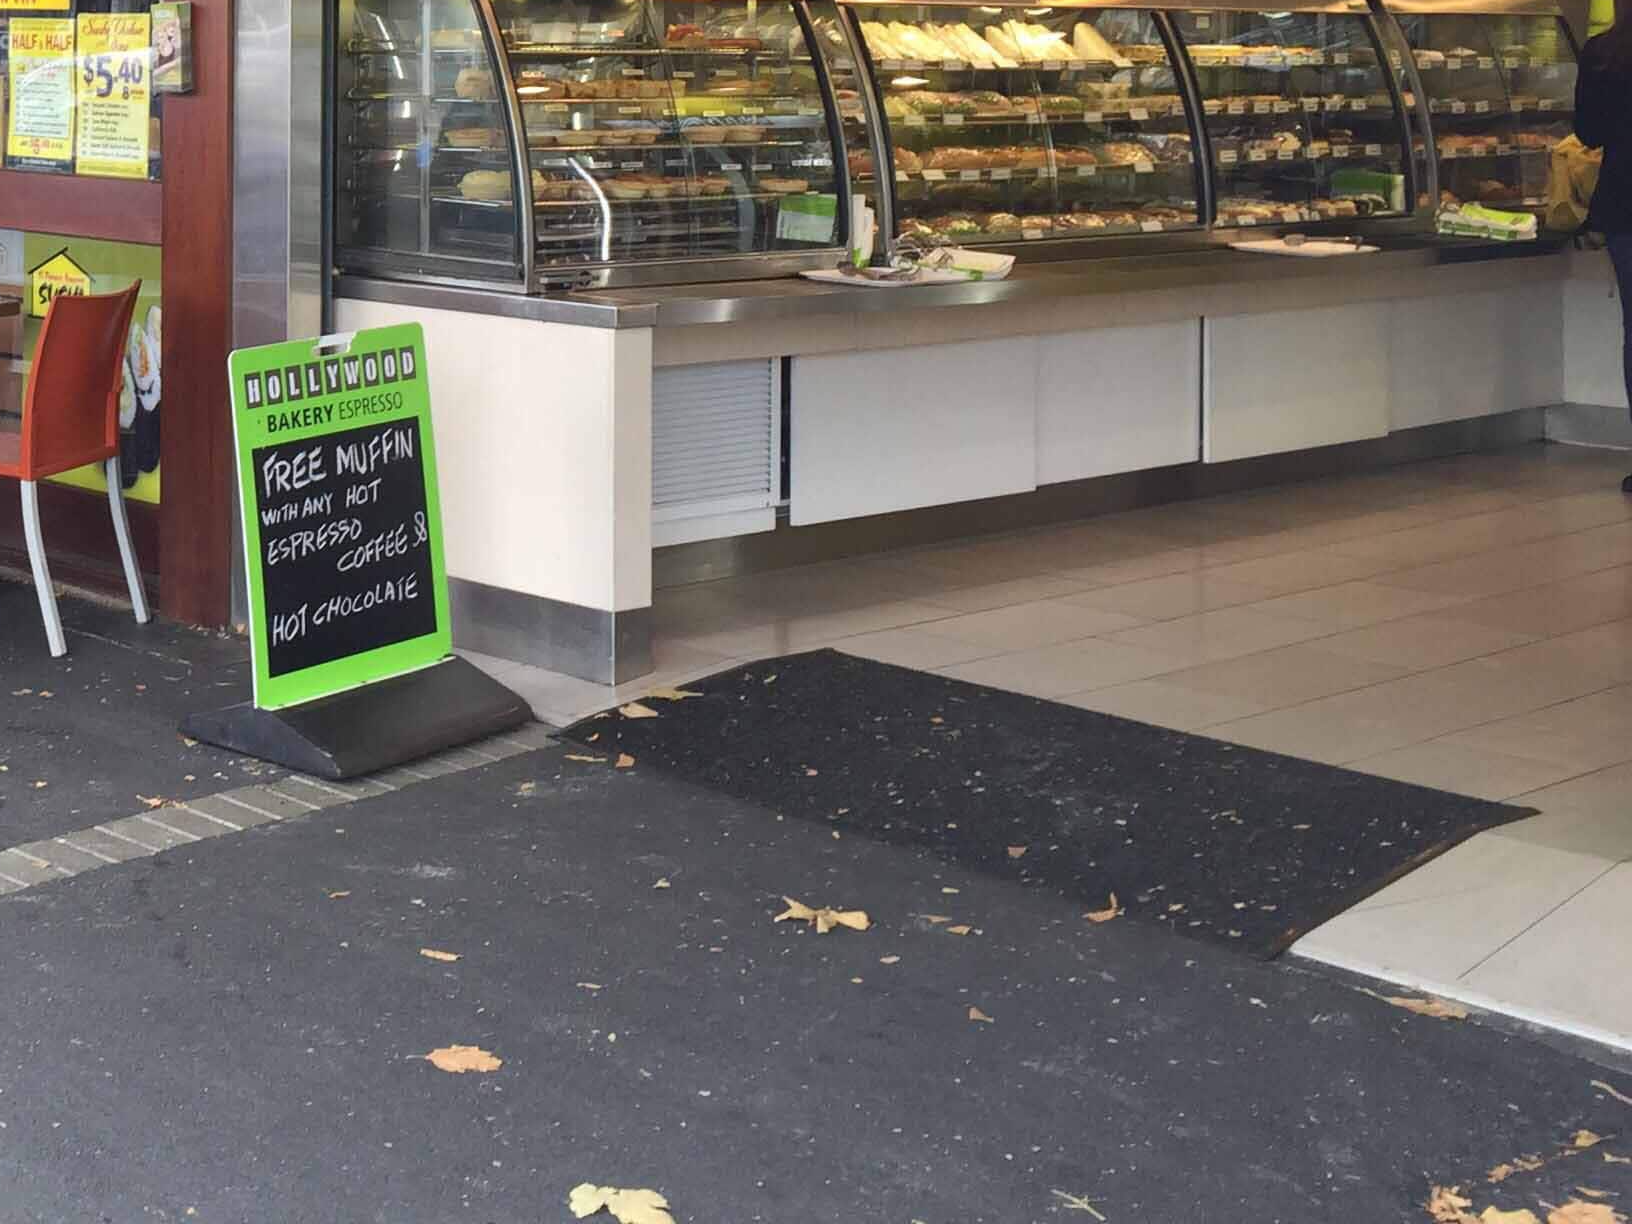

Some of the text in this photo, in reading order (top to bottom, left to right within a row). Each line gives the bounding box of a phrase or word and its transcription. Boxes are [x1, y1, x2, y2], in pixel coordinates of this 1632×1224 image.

[84, 56, 143, 98] $5.40
[248, 350, 415, 404] HOLLYWOOD
[268, 392, 402, 433] BAKERY ESPRESSO
[262, 428, 414, 498] FREE MUFFIN
[262, 479, 382, 527] WITH ANY HOT
[268, 518, 362, 566] ESPRESSO
[336, 523, 408, 572] COFFEE
[272, 572, 418, 646] HOT CHOCOLATE
